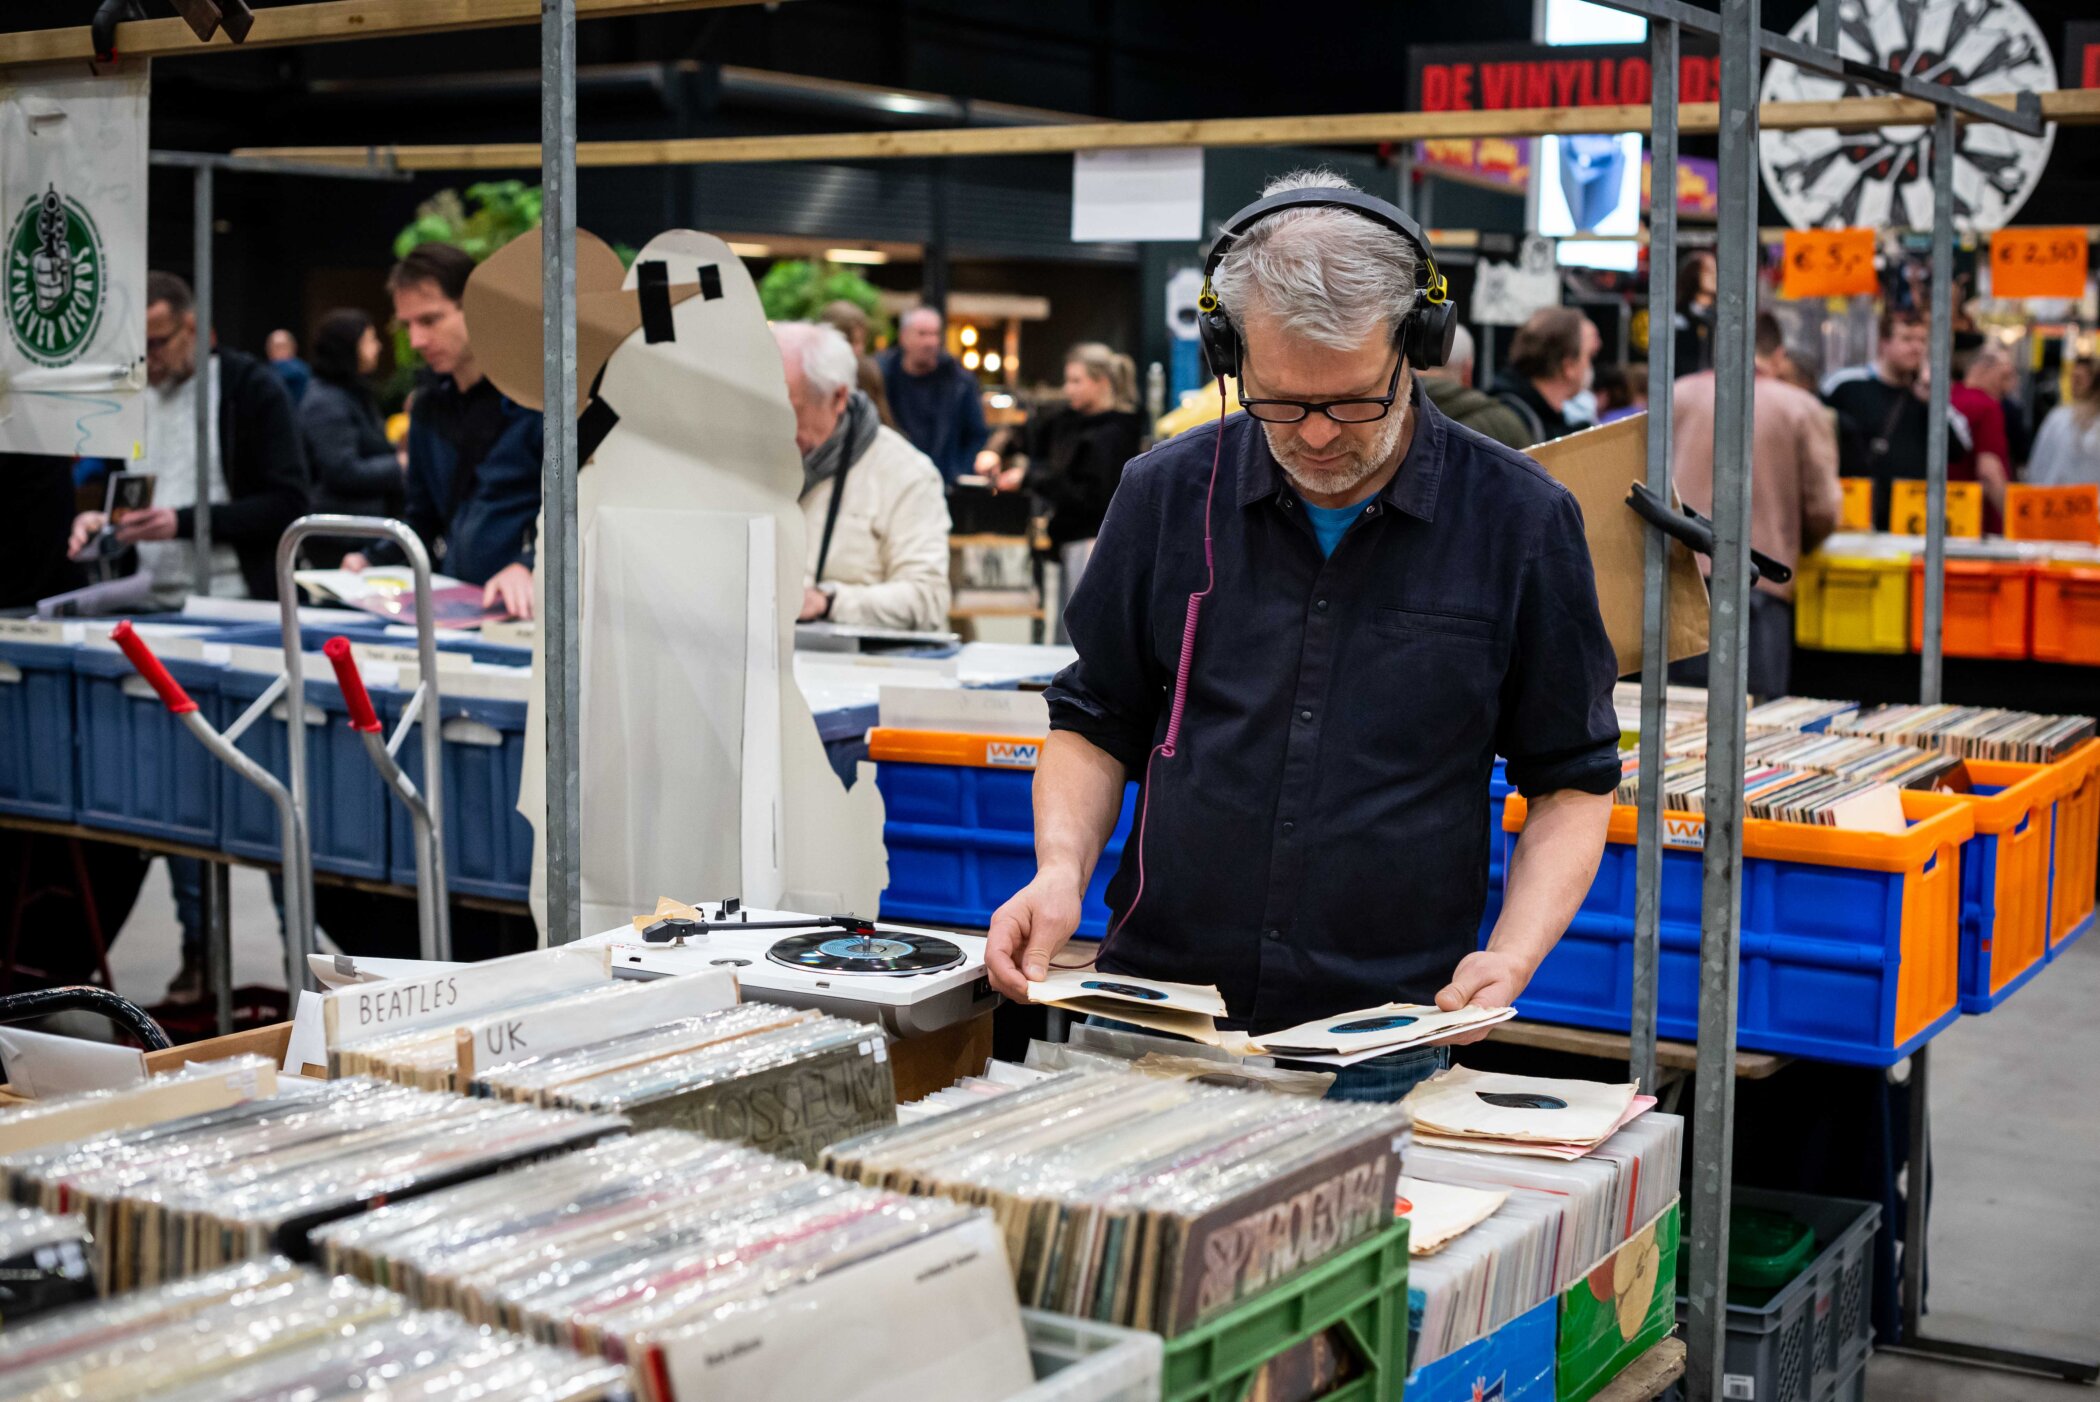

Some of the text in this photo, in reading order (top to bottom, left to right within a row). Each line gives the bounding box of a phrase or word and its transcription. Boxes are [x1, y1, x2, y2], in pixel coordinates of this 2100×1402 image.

[1422, 54, 1720, 112] DE VINYLLOD
[13, 250, 55, 350] REVOLVER
[58, 246, 94, 345] RECORDS
[358, 977, 458, 1026] BEATLES
[486, 1020, 528, 1056] UK
